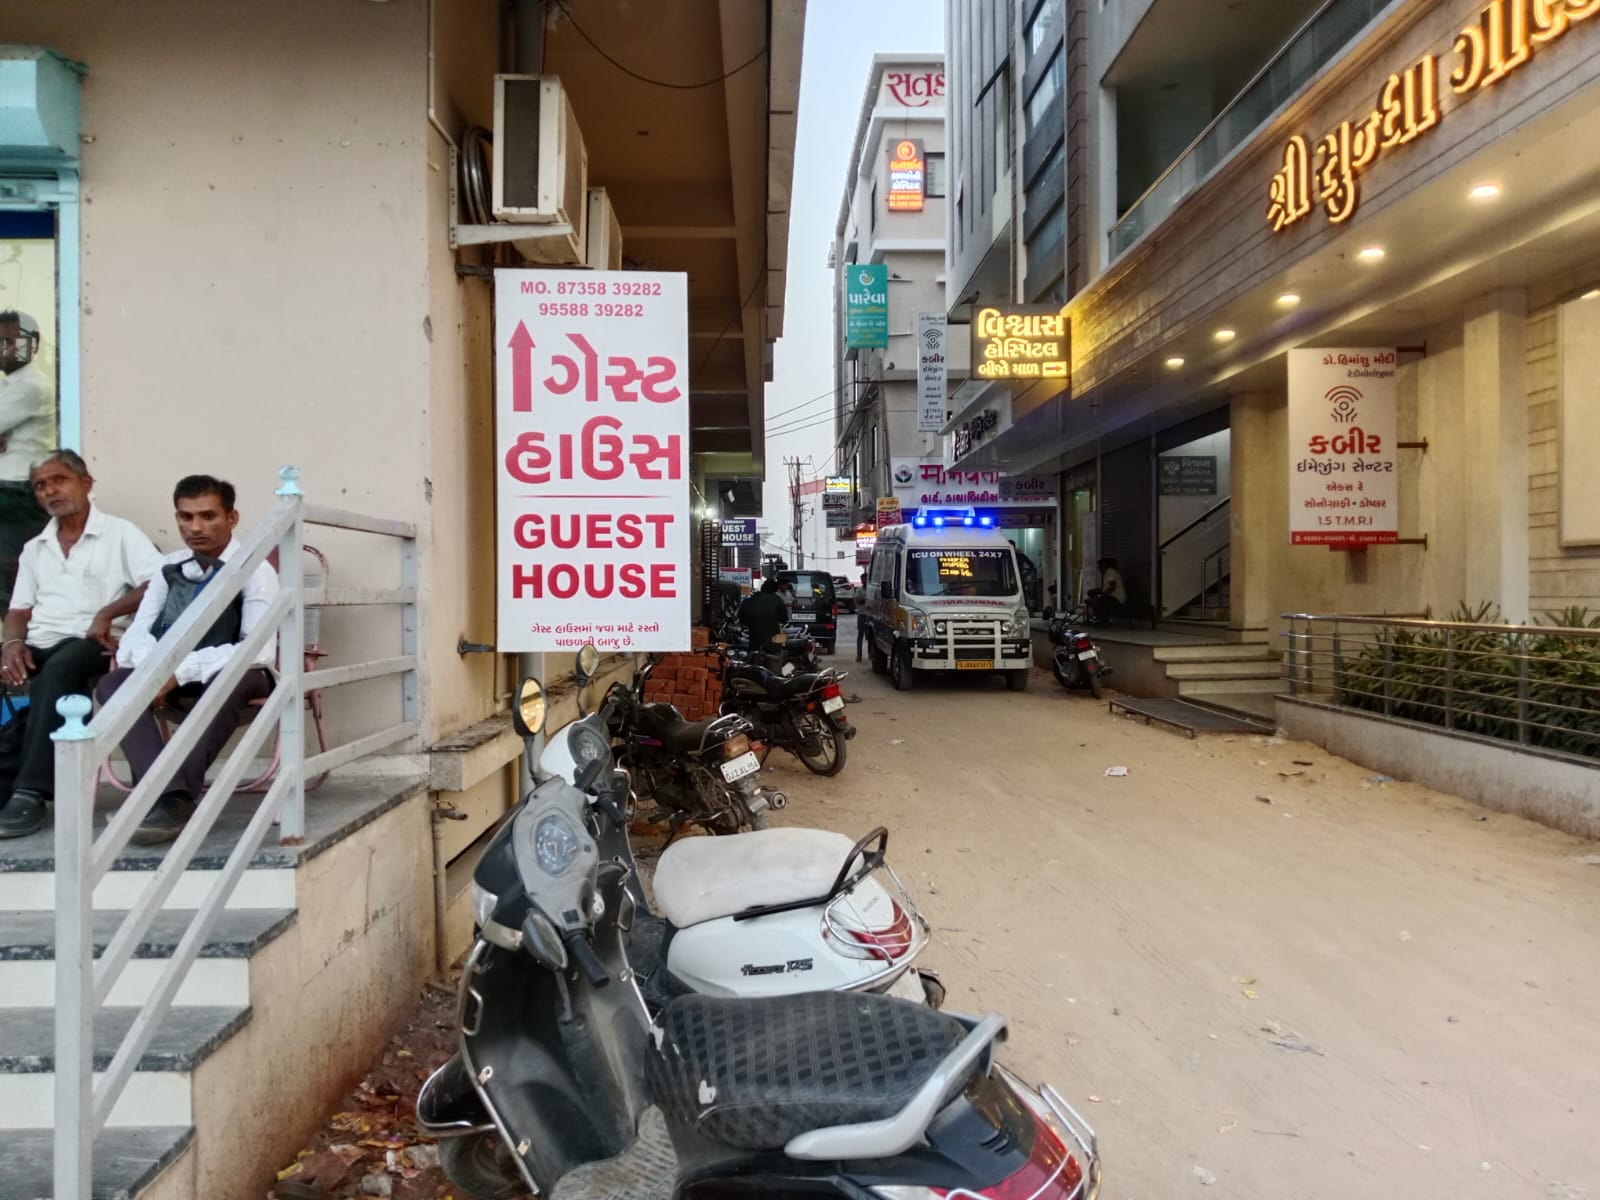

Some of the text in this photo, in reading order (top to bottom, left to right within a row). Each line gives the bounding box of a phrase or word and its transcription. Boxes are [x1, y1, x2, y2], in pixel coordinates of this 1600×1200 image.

[520, 281, 662, 296] MO. 87358 39282
[849, 289, 886, 305] પારેવા
[539, 303, 644, 317] 95588 39282
[977, 308, 1065, 338] વિશ્વાસ
[984, 337, 1060, 359] હોસ્પિટલ
[543, 333, 682, 403] ગેસ્ટ
[1308, 426, 1382, 455] કબીર
[505, 415, 682, 485] હાઉસ
[1352, 457, 1393, 473] સેન્ટર
[513, 513, 675, 549] GUEST
[722, 524, 747, 533] UEST
[722, 533, 755, 541] HOUSE
[512, 563, 677, 599] HOUSE
[617, 622, 634, 633] માટે
[598, 637, 620, 649] બાજુ
